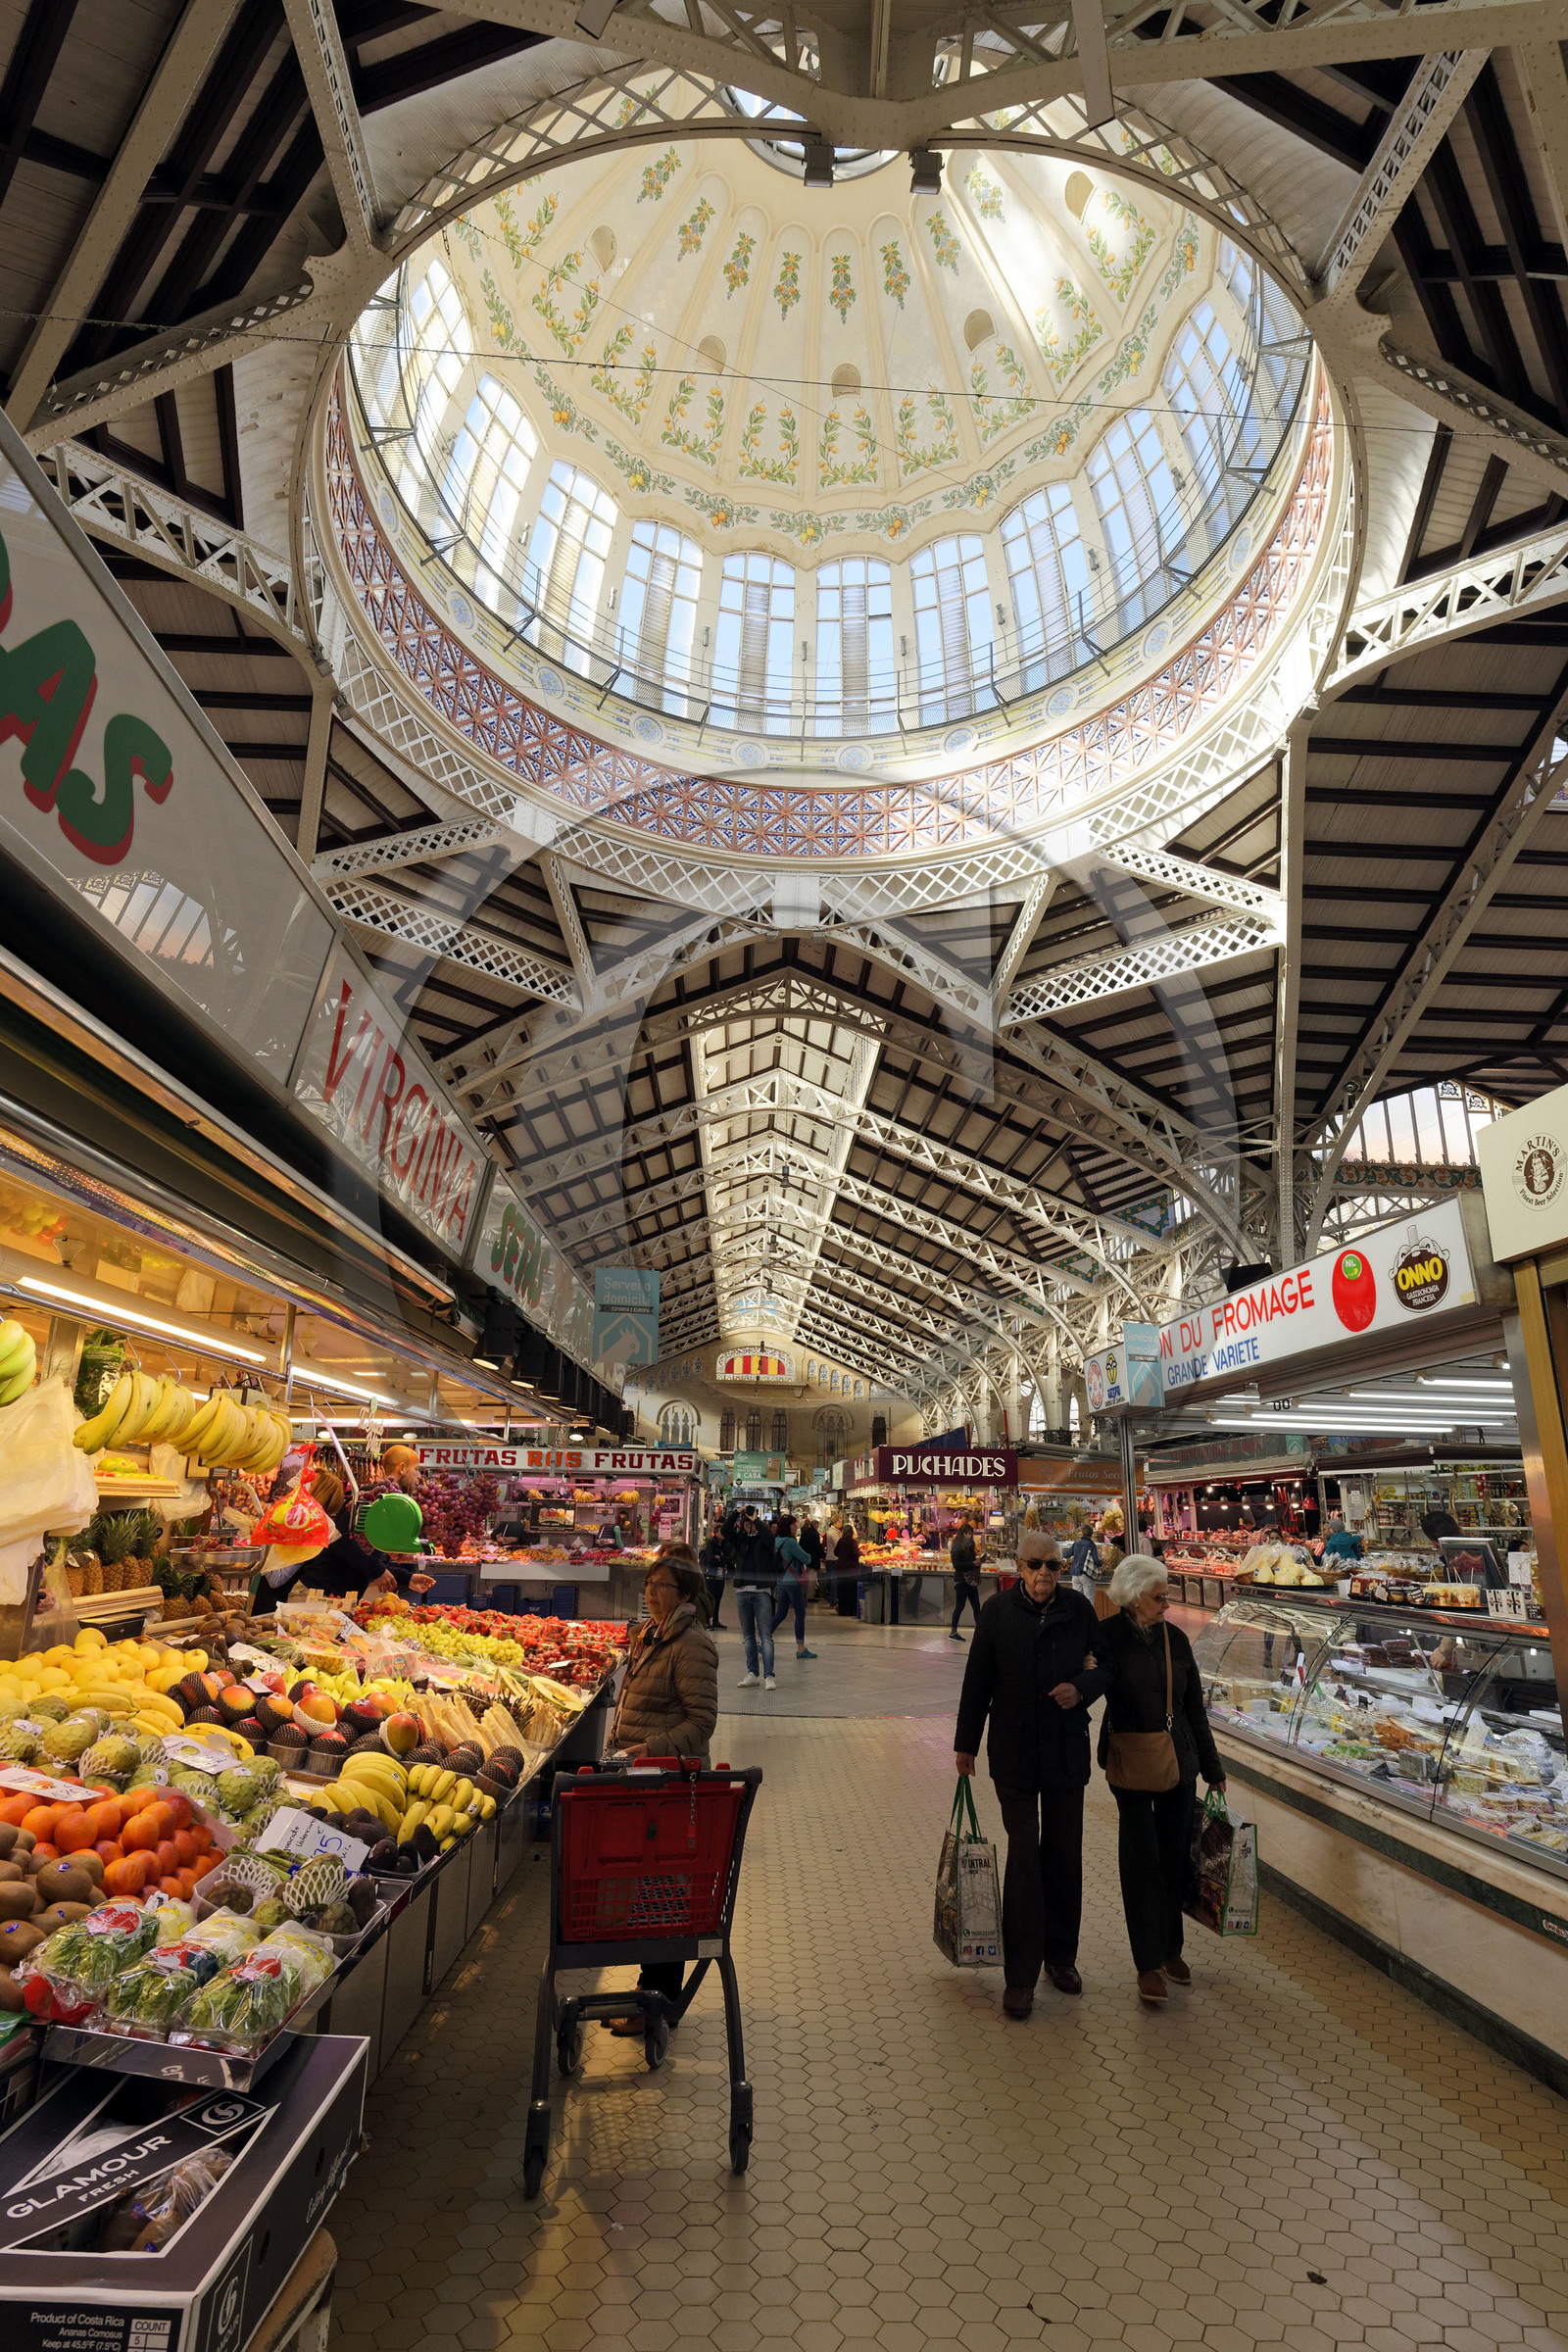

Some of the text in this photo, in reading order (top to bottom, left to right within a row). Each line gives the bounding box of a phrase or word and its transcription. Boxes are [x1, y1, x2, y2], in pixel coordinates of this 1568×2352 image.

[0, 525, 173, 865] AS
[322, 978, 475, 1242] VIRGINIA
[1516, 1136, 1560, 1172] MARTIN'S
[1519, 1172, 1564, 1206] Finest Beer Selection
[491, 1202, 551, 1308] SETAS
[604, 1277, 641, 1291] Servei
[1397, 1257, 1443, 1291] ONNO
[604, 1293, 651, 1305] domicili
[1180, 1316, 1202, 1352] DU
[1212, 1269, 1315, 1341] FROMAGE
[1412, 1294, 1436, 1306] FRANCESA
[1168, 1337, 1259, 1386] GRANDE VARIETE
[418, 1448, 516, 1466] FRUTAS
[594, 1452, 694, 1470] FRUTAS
[892, 1454, 1005, 1477] PUCHADES
[1068, 1467, 1099, 1479] Frutos
[6, 2134, 172, 2219] GLAMOUR
[77, 2169, 140, 2202] FRESH
[30, 2312, 124, 2328] Product of Costa Rica
[134, 2321, 167, 2332] COUNT
[42, 2339, 61, 2349] Keep
[59, 2328, 123, 2339] Ananas Comosus
[134, 2336, 140, 2345] 5
